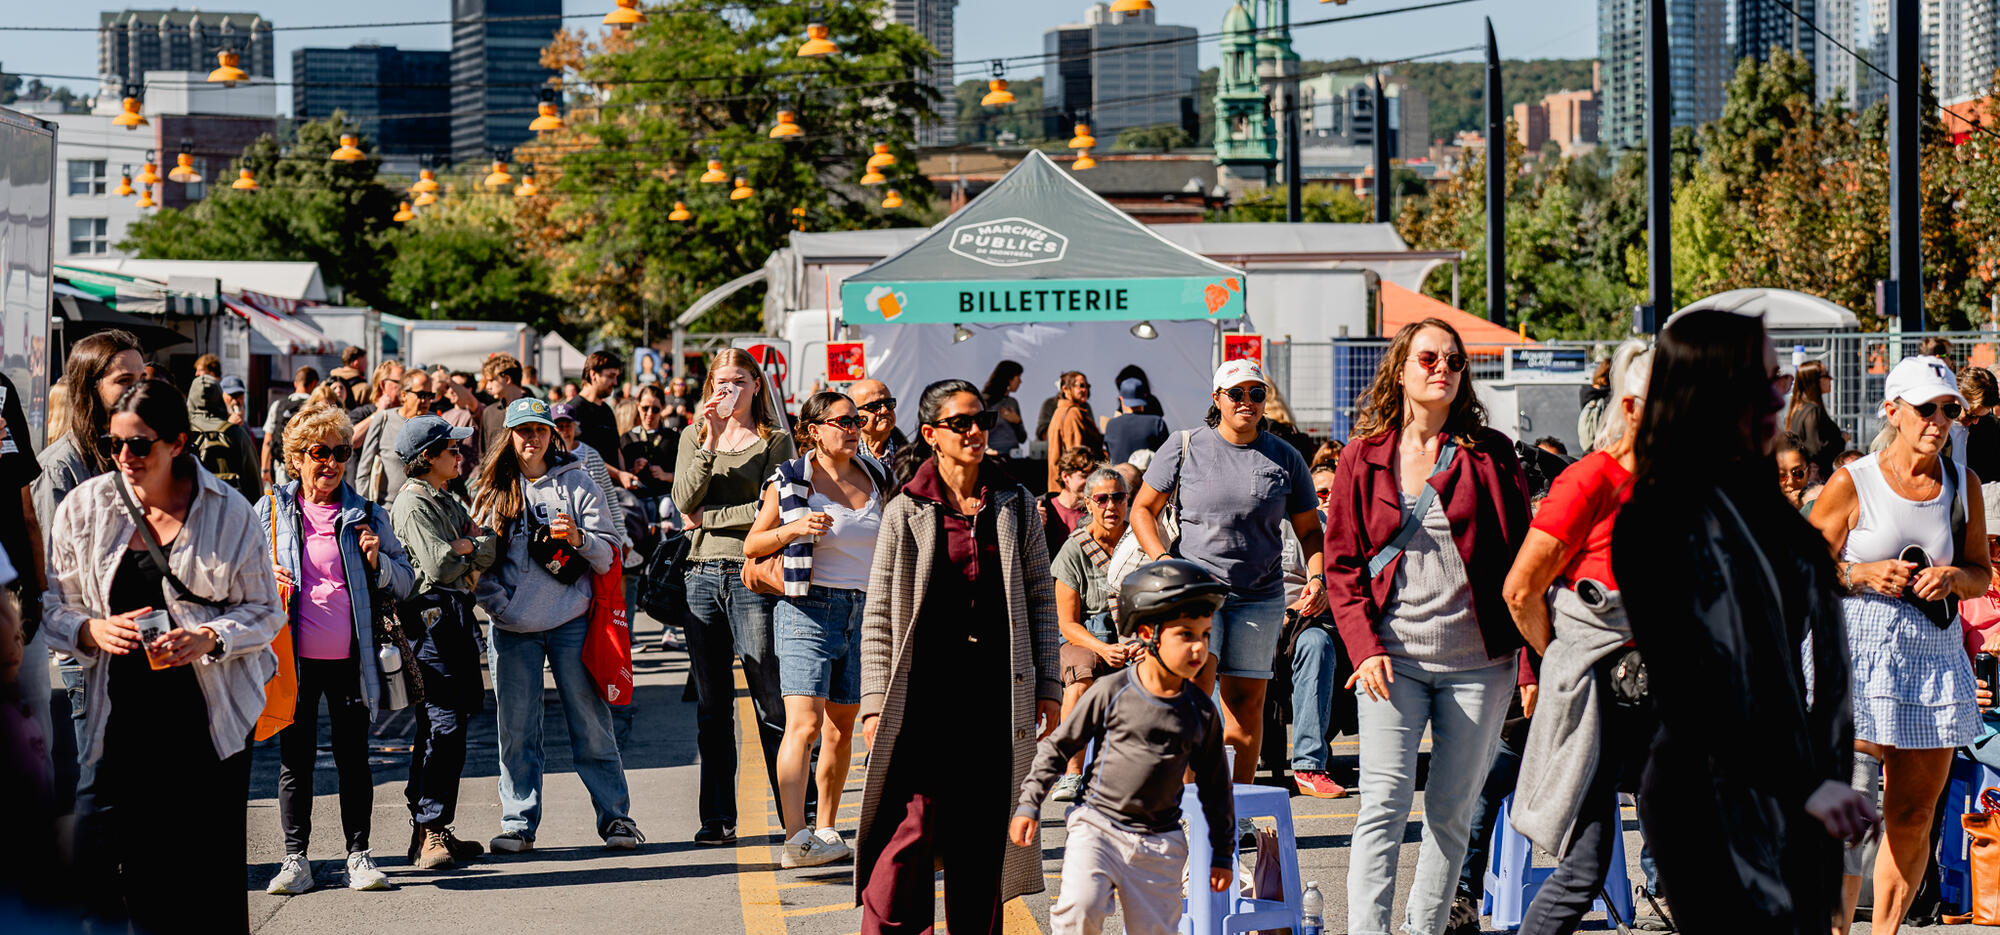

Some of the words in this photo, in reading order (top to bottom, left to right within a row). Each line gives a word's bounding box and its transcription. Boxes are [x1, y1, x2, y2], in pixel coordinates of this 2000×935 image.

[960, 233, 1058, 253] PUBLICS
[978, 225, 1048, 241] MARCHÉS
[959, 289, 1128, 313] BILLETTERIE
